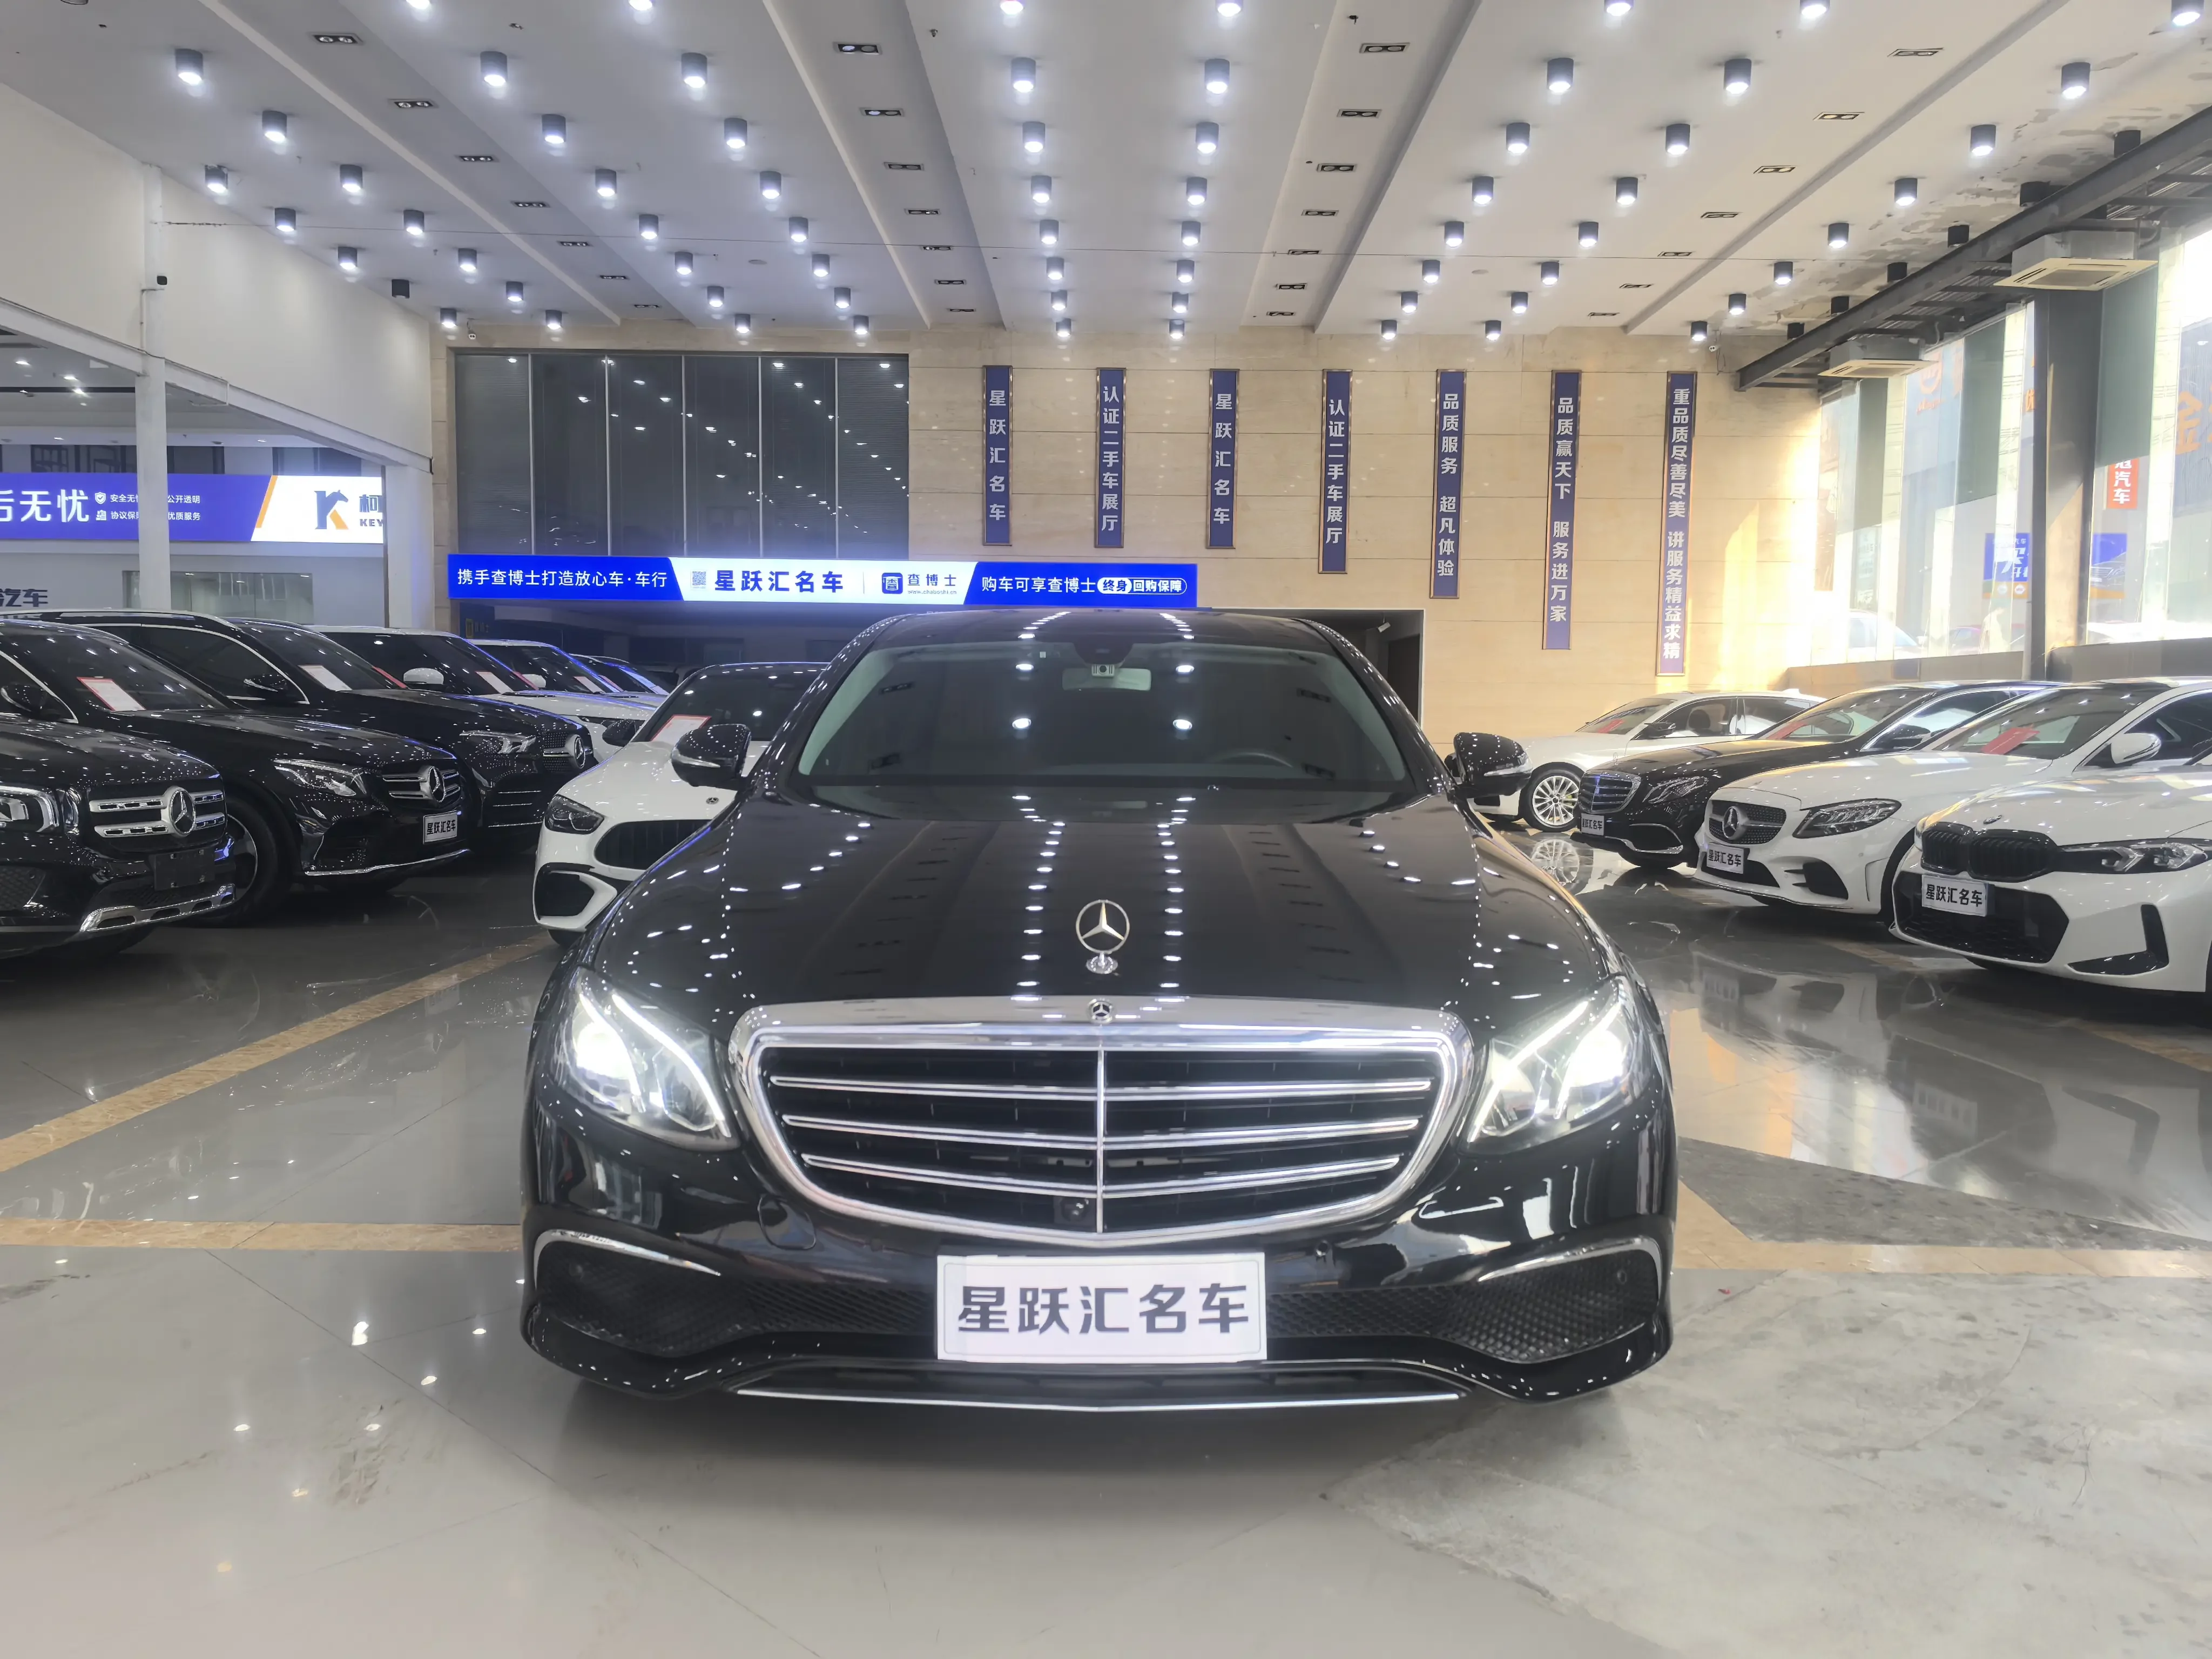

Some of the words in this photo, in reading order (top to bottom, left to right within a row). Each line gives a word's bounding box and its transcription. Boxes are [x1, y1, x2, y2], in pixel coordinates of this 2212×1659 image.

[989, 390, 1006, 521] 星跃汇名车
[1102, 386, 1120, 531] 认证二手车展厅
[1213, 393, 1232, 524] 星跃汇名车
[1326, 399, 1345, 544] 认证二手车展厅
[1441, 393, 1459, 475] 品质服务
[1555, 397, 1574, 500] 品质赢天下
[1668, 388, 1690, 518] 重品质尽善尽美
[110, 494, 138, 503] 安全无
[167, 495, 200, 503] 公开透明
[111, 510, 139, 520] 协议保
[168, 511, 200, 521] 优质服务
[1437, 496, 1456, 576] 超凡体验
[714, 569, 844, 594] 星跃汇名车
[908, 574, 956, 586] 查博士
[1550, 521, 1569, 622] 服务进万家
[1663, 531, 1684, 659] 讲服务精益求精
[427, 819, 456, 835] 星跃汇名车
[1708, 849, 1742, 867] 星跃汇名车
[1926, 884, 1982, 907] 星跃汇名车
[958, 1283, 1249, 1335] 星跃汇名车
